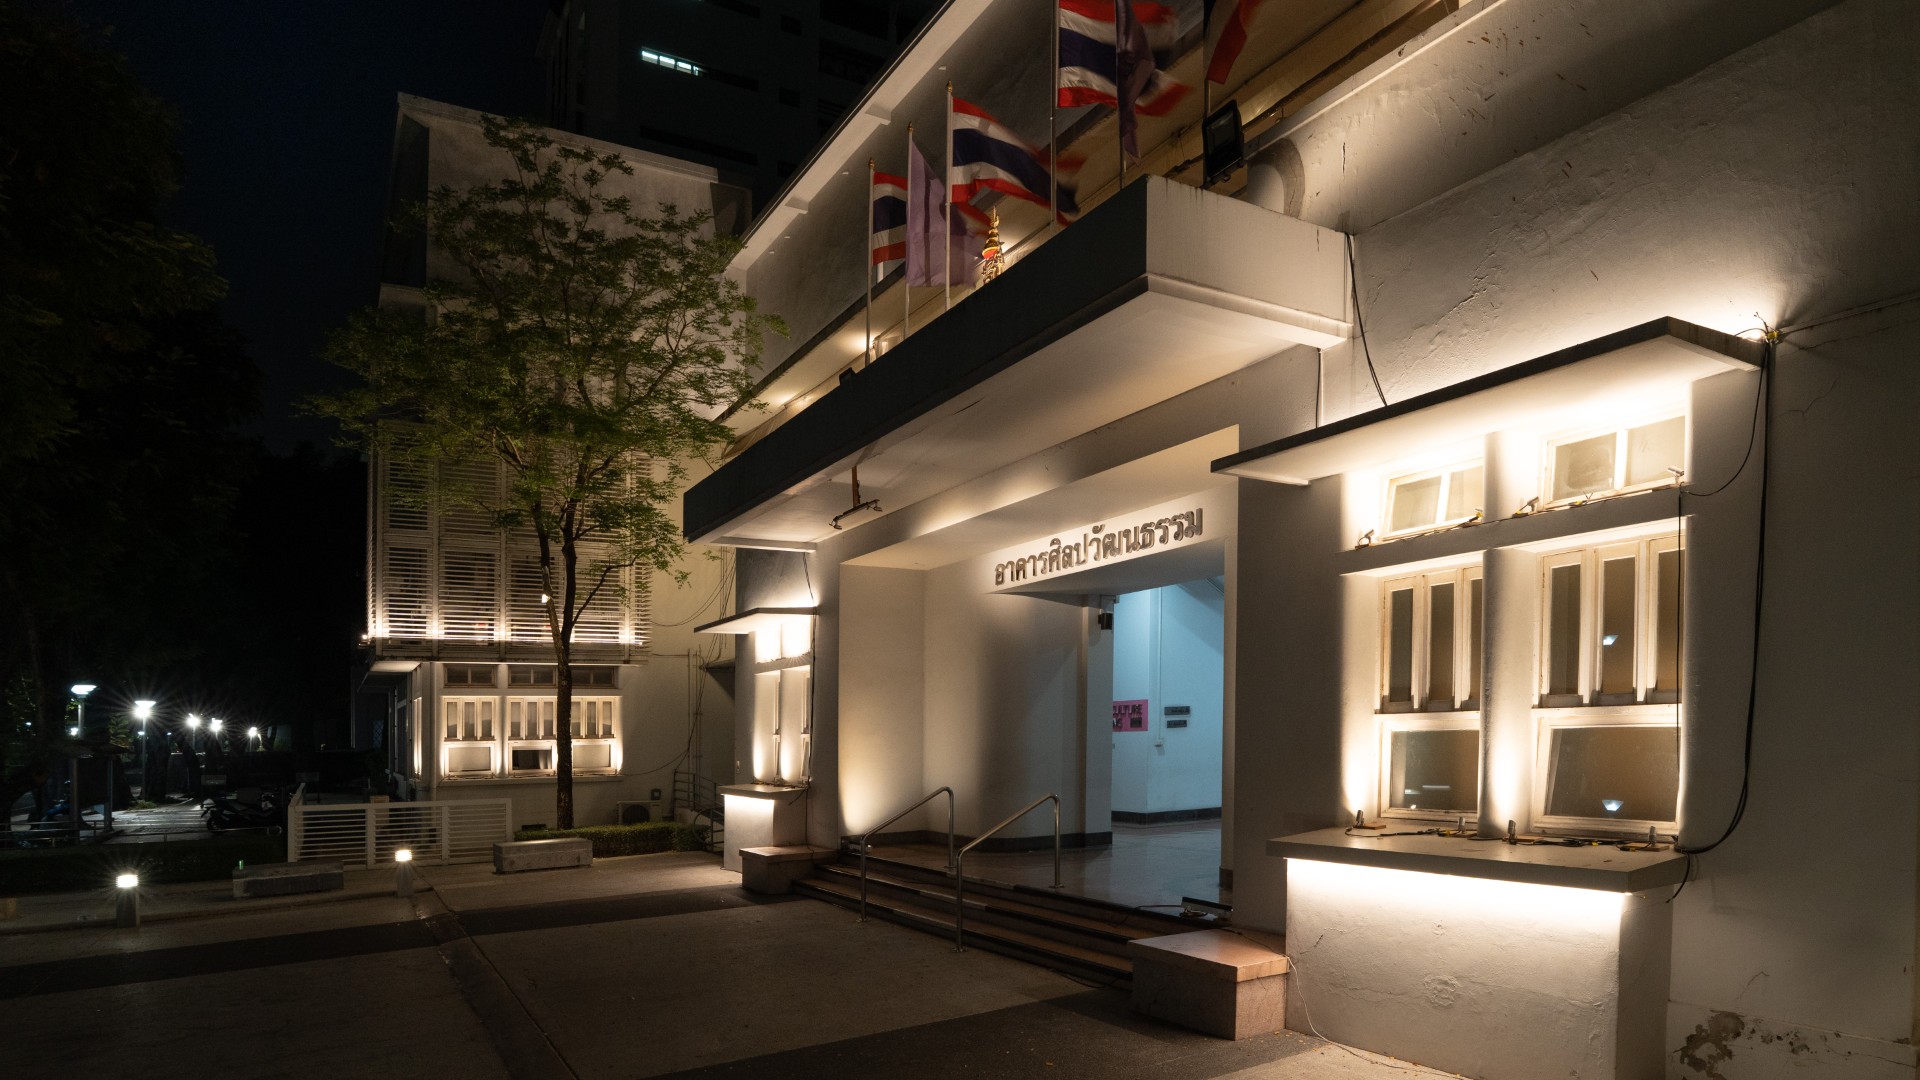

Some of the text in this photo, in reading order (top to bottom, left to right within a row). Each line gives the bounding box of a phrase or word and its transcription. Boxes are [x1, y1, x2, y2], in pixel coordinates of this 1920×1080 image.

[995, 507, 1203, 585] อาคารศิลปวัฒนธรรม
